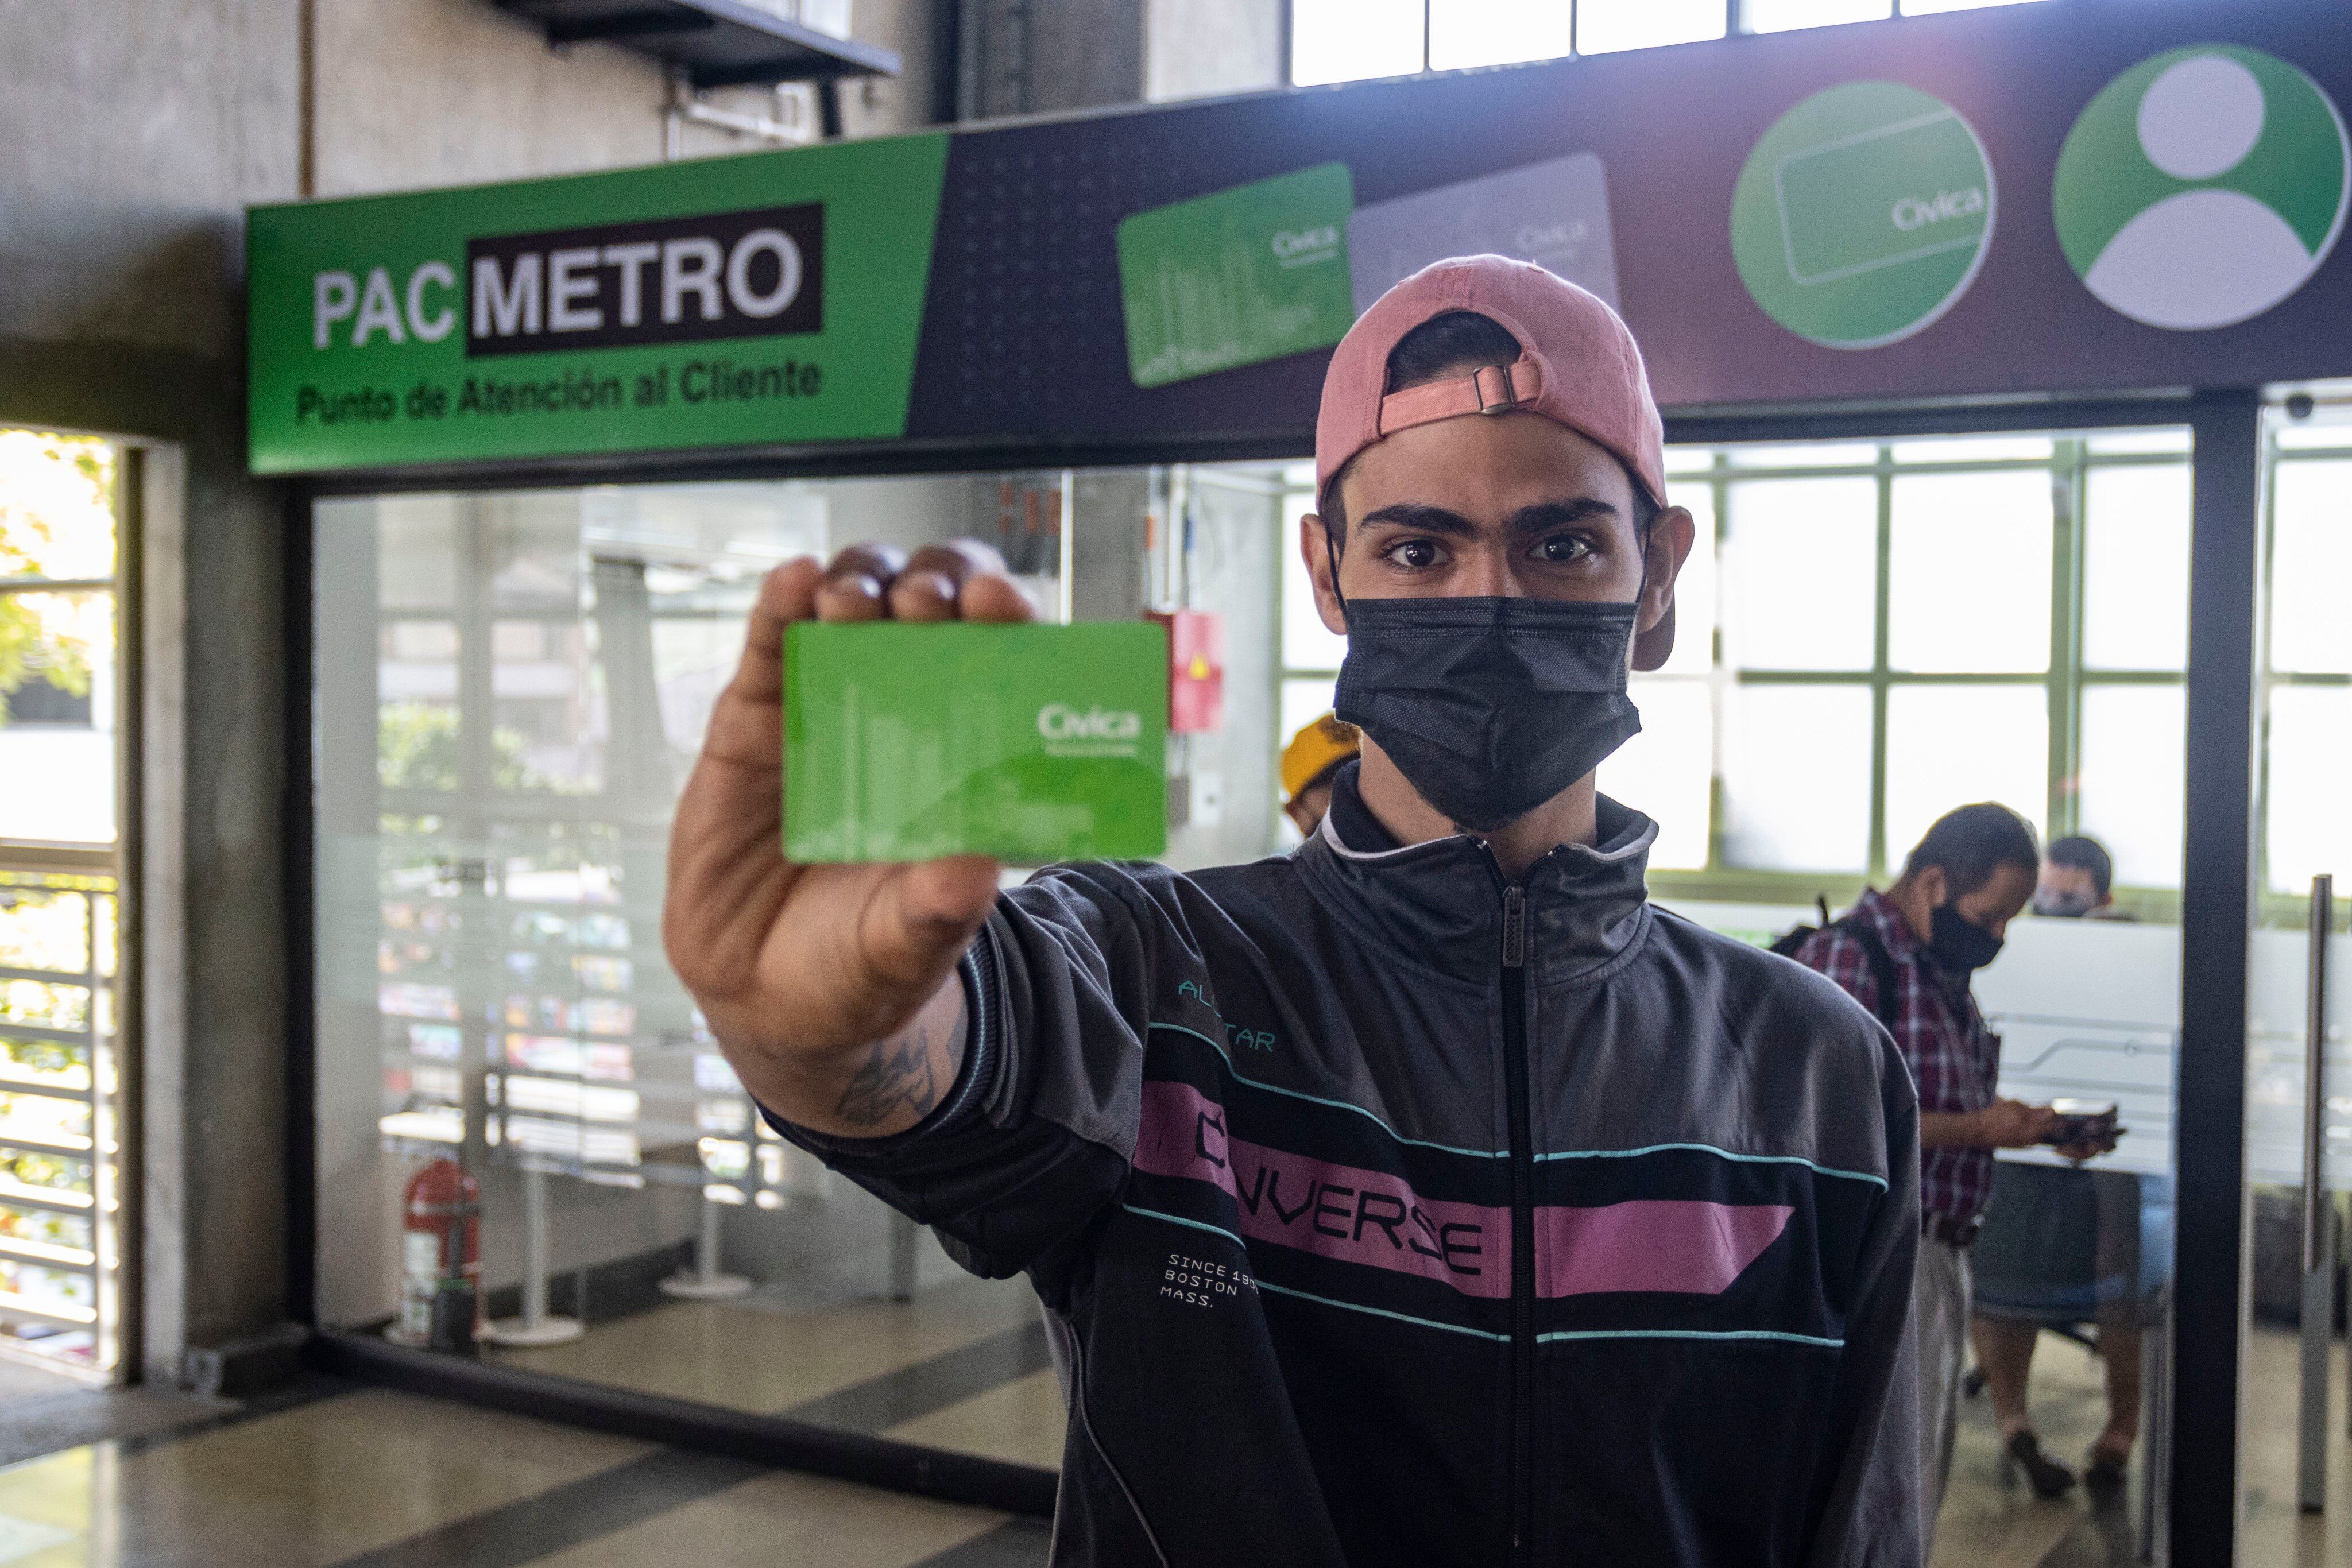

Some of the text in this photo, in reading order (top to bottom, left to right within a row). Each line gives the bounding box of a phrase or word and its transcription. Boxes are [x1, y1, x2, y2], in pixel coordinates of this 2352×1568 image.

[312, 228, 804, 350] PAC METRO
[297, 359, 822, 426] Punto de Atención al Cliente
[1178, 979, 1276, 1053] ALL TAR
[1195, 1110, 1482, 1276] CNVERSE
[1160, 1286, 1213, 1308] MASS.
[1165, 1269, 1237, 1296] BOSTON
[1169, 1254, 1227, 1277] SINCE
